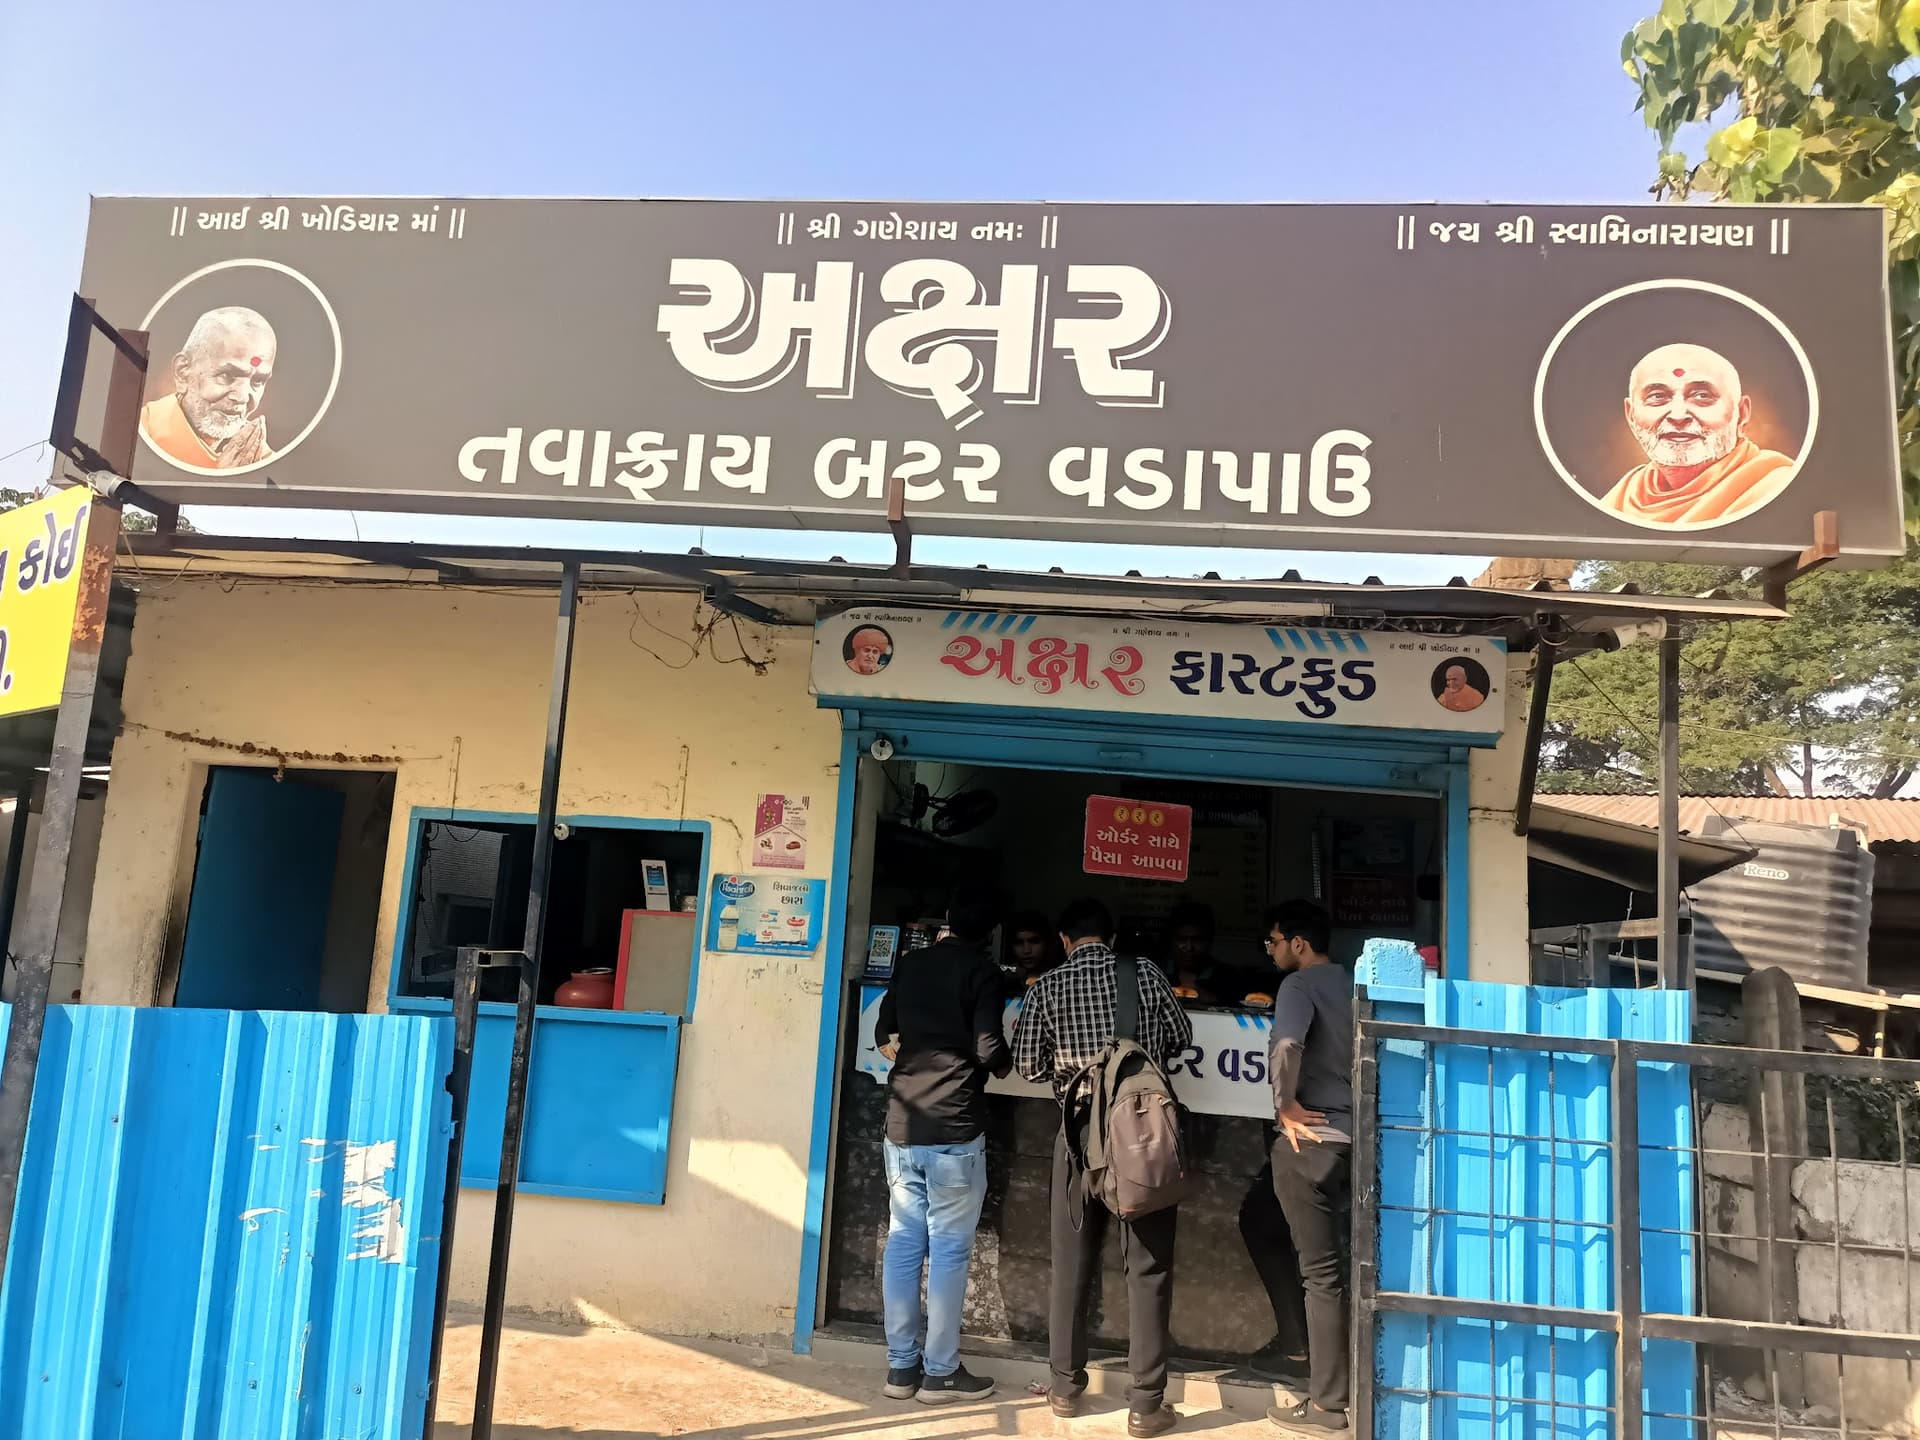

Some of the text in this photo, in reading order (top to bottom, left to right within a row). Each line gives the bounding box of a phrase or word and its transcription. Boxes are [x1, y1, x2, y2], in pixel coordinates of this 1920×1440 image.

[197, 206, 250, 230] આઈ
[258, 205, 290, 230] શ્રી
[301, 204, 400, 232] ખોડિયાર
[410, 204, 440, 233] માં
[806, 212, 841, 239] શ્રી
[853, 212, 958, 241] ગણેશાય
[1429, 221, 1480, 243] જય
[1495, 215, 1534, 244] શ્રી
[1549, 214, 1754, 246] સ્વામિનારાયણ
[657, 257, 1172, 432] અક્ષર
[813, 437, 1002, 504] બટર
[1048, 428, 1374, 517] વડાપાઉ
[18, 505, 88, 592] કોઈ
[940, 635, 1146, 697] અક્ષર
[1096, 825, 1181, 850] ઓર્ડર સાથે
[1089, 845, 1183, 872] પૈસા આપવા
[1747, 864, 1787, 879] Reno
